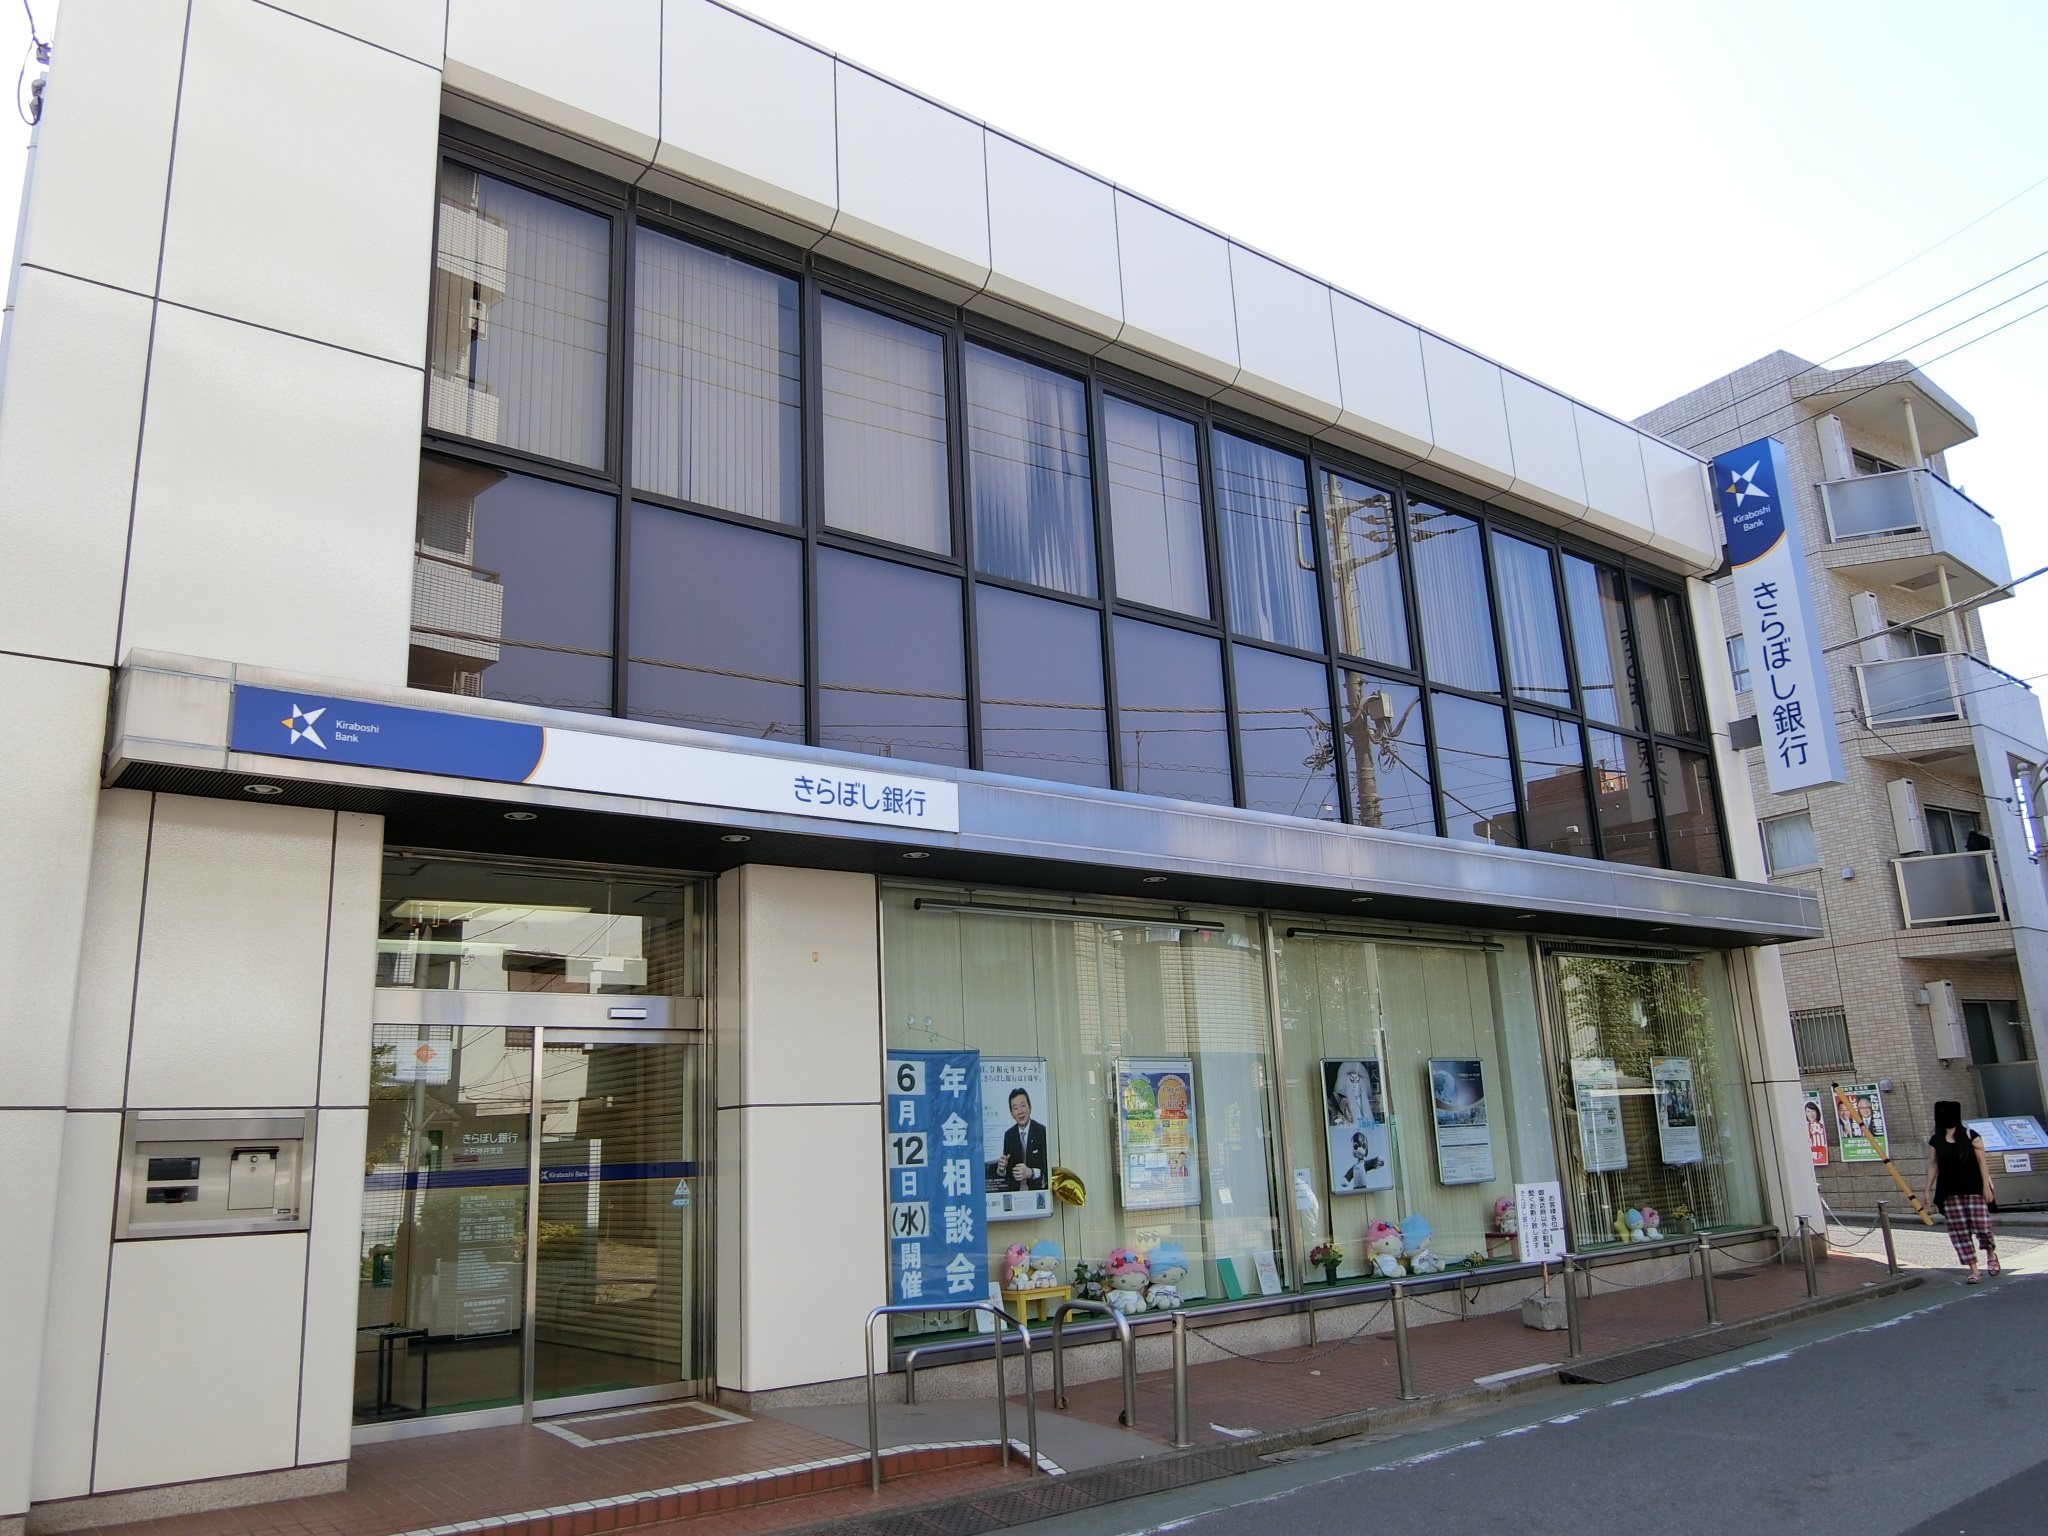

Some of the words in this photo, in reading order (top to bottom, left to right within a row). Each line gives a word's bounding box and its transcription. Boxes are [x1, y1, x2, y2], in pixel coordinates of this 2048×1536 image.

[1732, 504, 1772, 525] Kiraboshi
[1743, 518, 1764, 532] Bank
[1753, 581, 1809, 769] きらぼし銀行
[335, 719, 380, 735] Kiraboshi
[335, 732, 359, 744] Bank
[793, 775, 927, 818] きらぼし銀行
[462, 1131, 518, 1144] きらぼし銀行
[549, 1171, 574, 1179] Kiraboshi
[939, 1063, 976, 1296] 年金相談会
